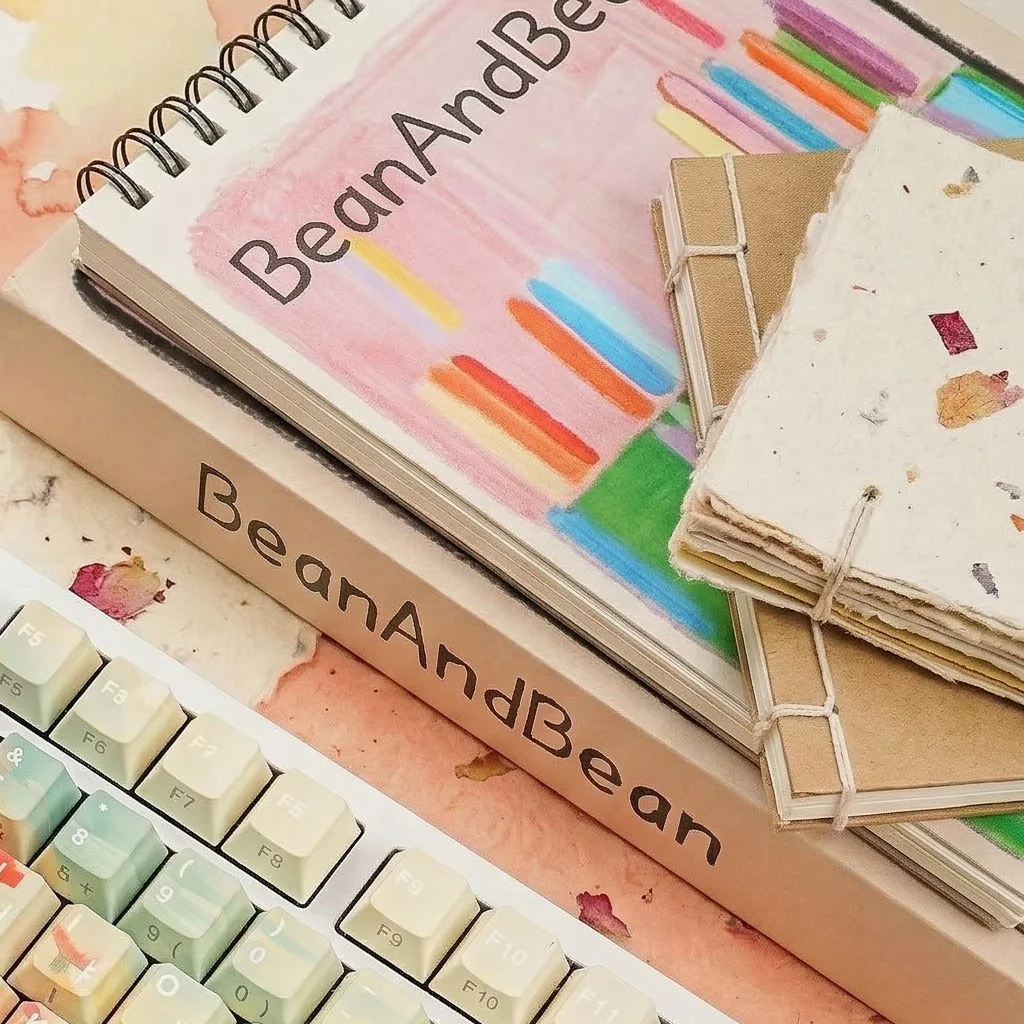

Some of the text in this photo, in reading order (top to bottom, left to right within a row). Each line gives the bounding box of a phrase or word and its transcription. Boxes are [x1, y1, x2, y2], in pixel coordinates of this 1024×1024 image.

[230, 0, 633, 305] BeanAndBe
[196, 462, 722, 867] BeanAndBean
[0, 673, 23, 697] F5
[82, 731, 108, 755] F6
[6, 747, 24, 768] &
[169, 786, 196, 808] F7
[71, 828, 89, 846] 8
[179, 859, 194, 878] (
[257, 845, 284, 869] F8
[155, 885, 174, 904] 9
[268, 917, 285, 937] )
[376, 923, 403, 947] F9
[146, 925, 182, 959] 9 (
[156, 973, 180, 997] O
[462, 979, 499, 1011] F10
[259, 999, 269, 1018] )
